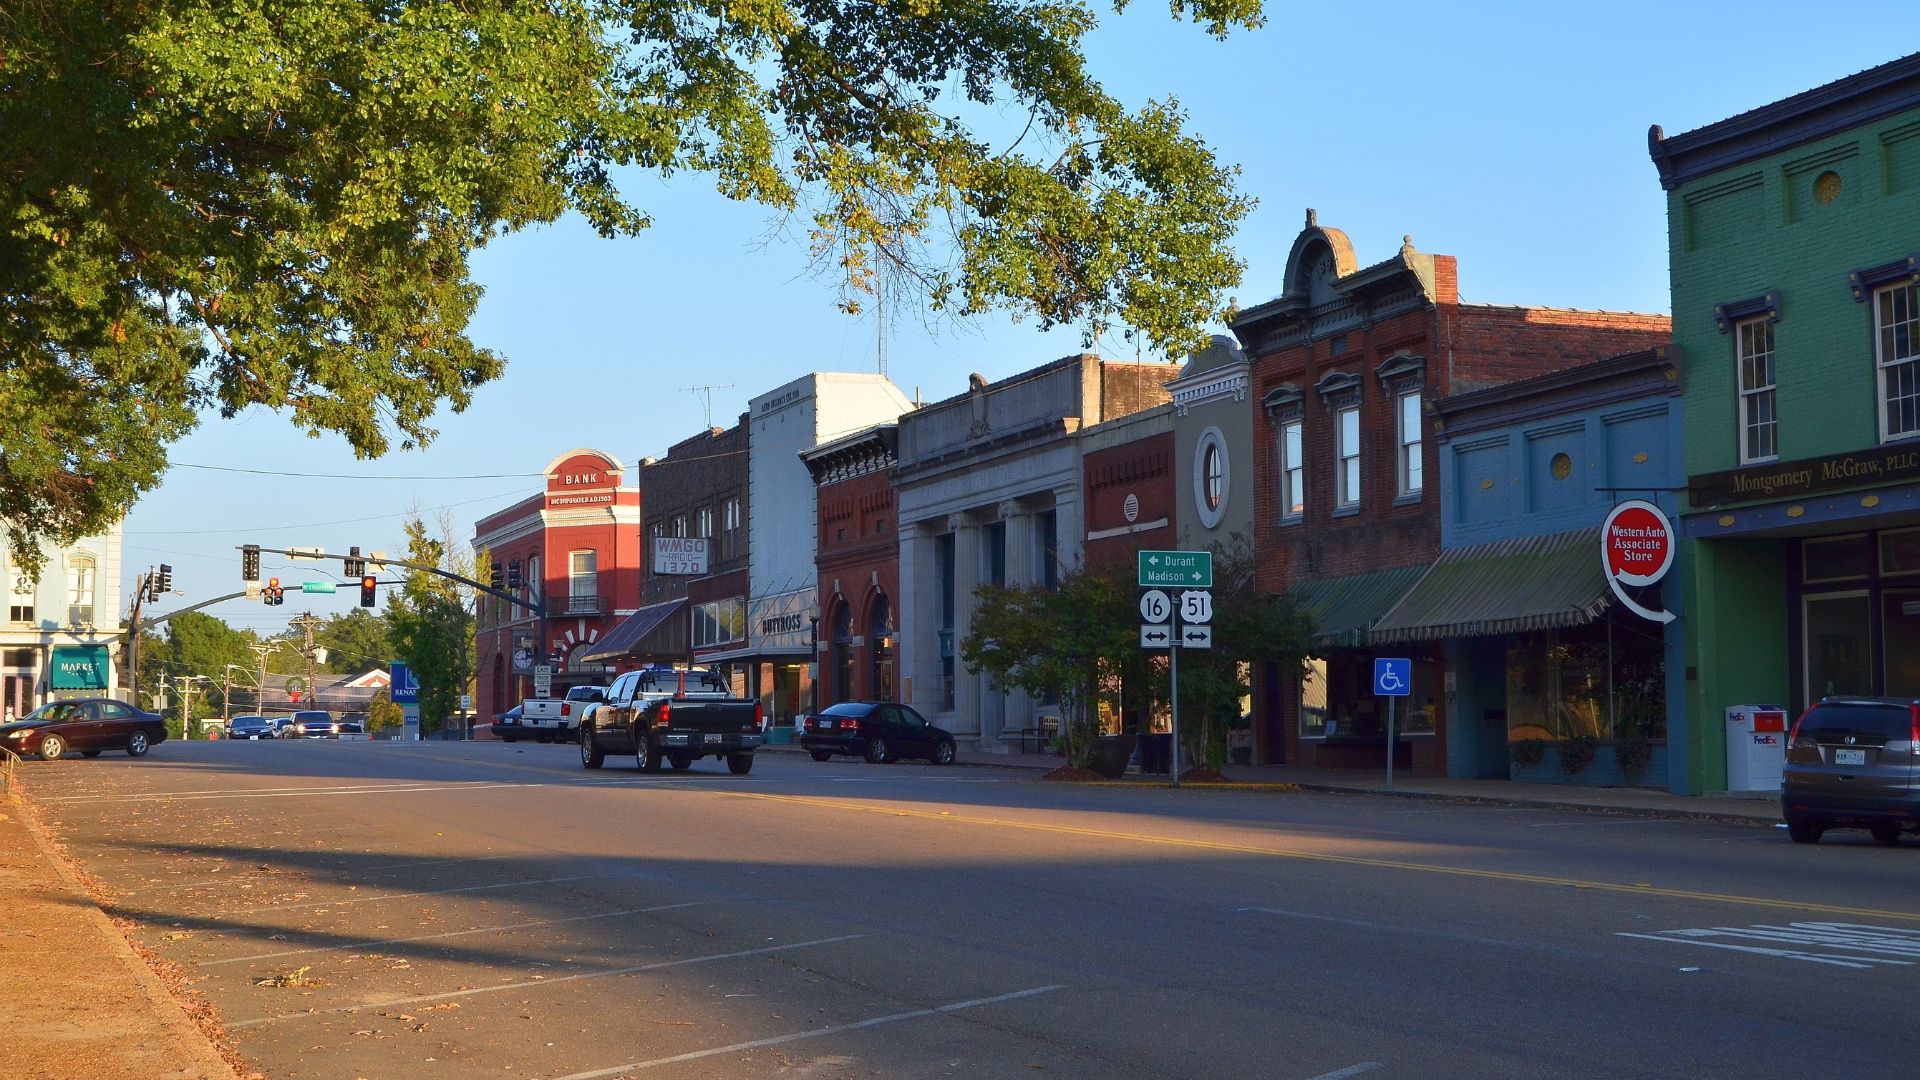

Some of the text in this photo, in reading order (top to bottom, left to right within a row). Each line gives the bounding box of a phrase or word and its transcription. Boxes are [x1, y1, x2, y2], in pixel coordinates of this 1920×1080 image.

[565, 473, 596, 485] BANK
[1732, 452, 1918, 494] Montgomery McGraw, PLLC
[1611, 525, 1666, 538] Western Auto
[658, 539, 705, 553] WMGO
[1614, 538, 1661, 550] Associate
[669, 553, 693, 562] RADIO
[1165, 556, 1196, 567] Durant
[1624, 550, 1653, 561] Store
[663, 561, 699, 573] 1370
[1148, 571, 1185, 581] Madison
[1146, 597, 1163, 617] 16
[1188, 597, 1205, 617] 51
[762, 614, 801, 635] BUTTROSS
[61, 662, 100, 671] MARKET
[1729, 712, 1746, 722] FedEx
[1753, 735, 1777, 745] FedEx
